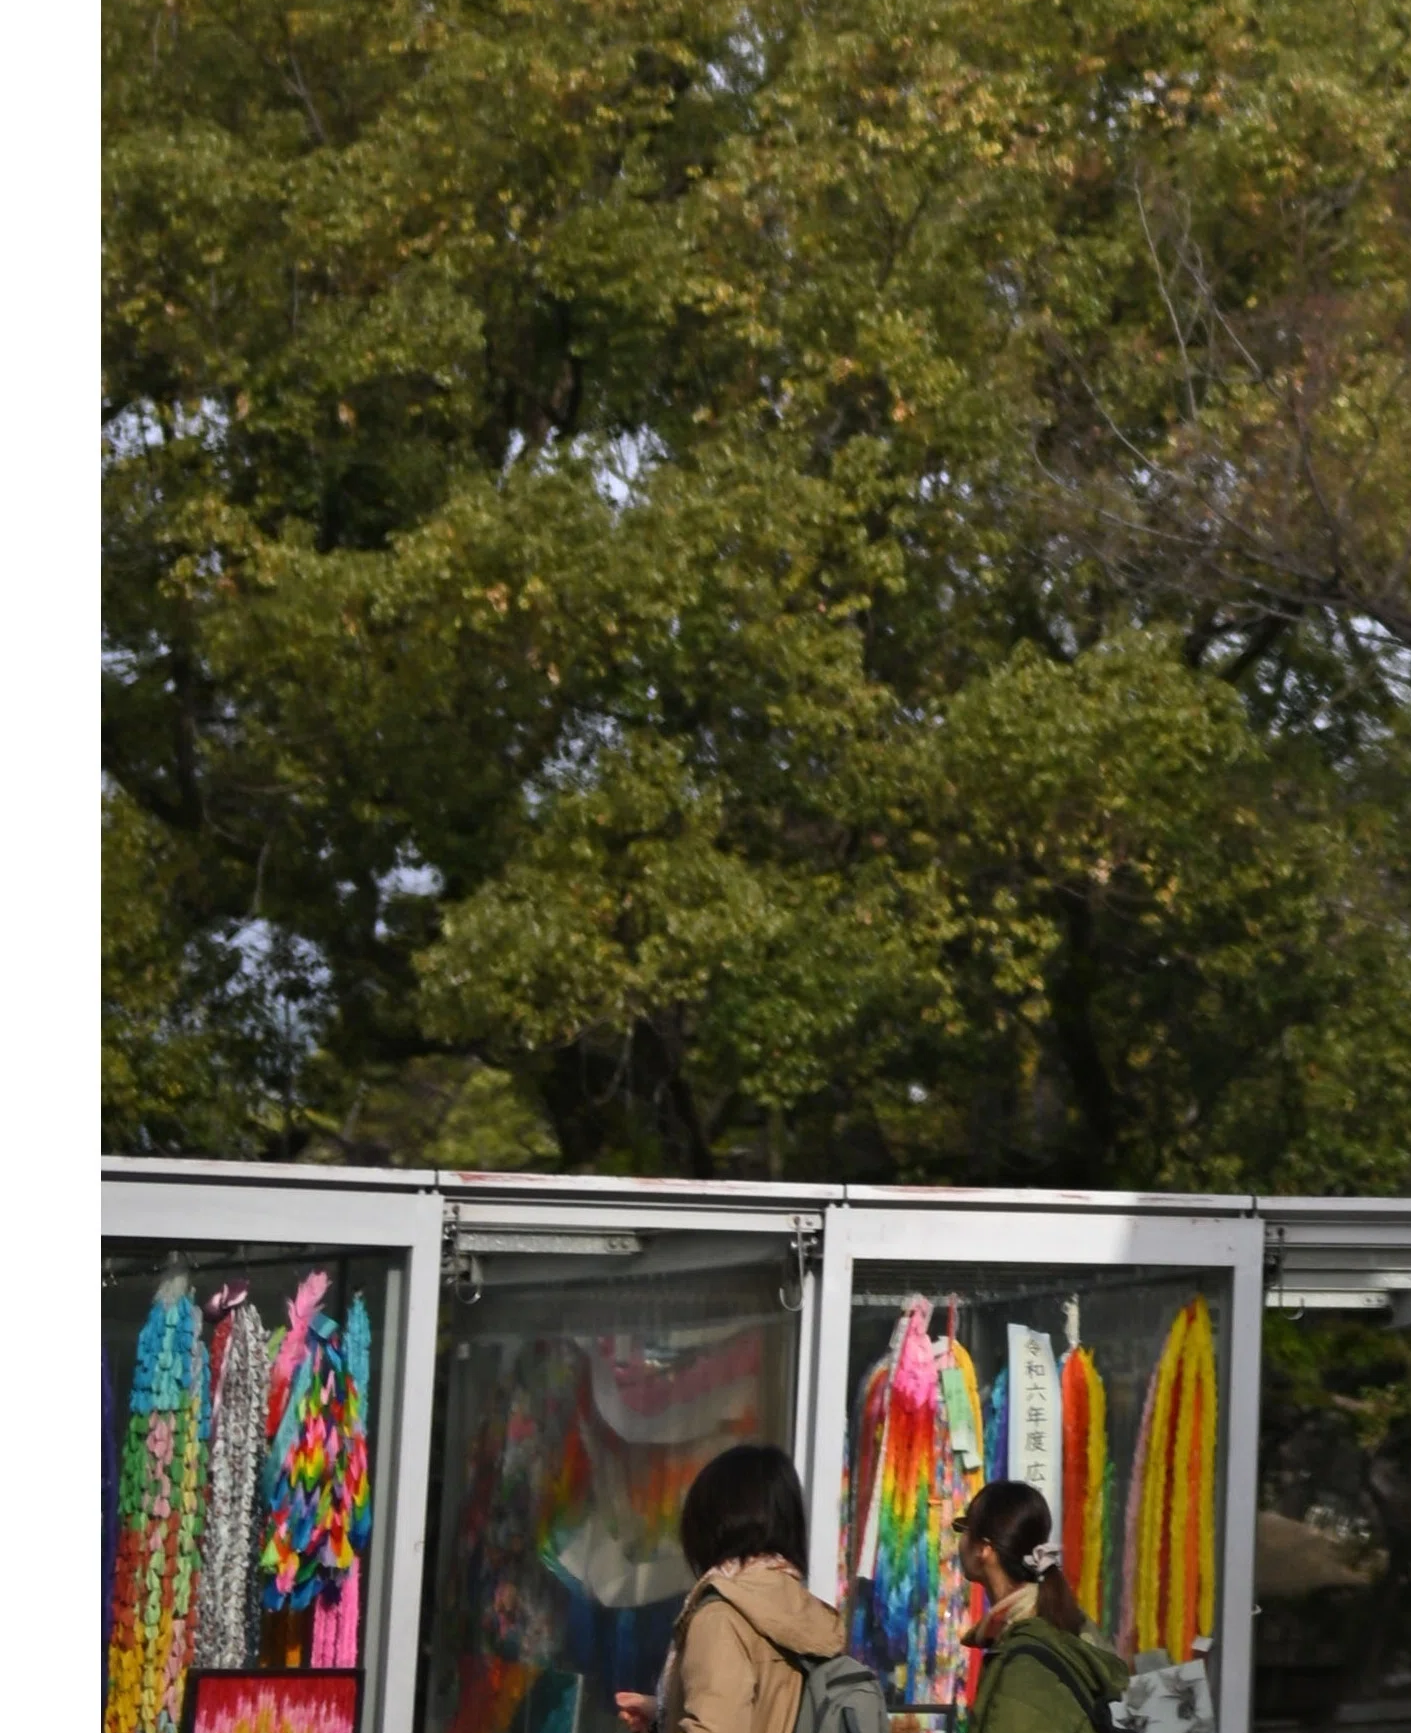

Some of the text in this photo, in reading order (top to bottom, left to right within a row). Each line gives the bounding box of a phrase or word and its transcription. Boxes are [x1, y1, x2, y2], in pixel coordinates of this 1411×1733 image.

[1025, 1337, 1048, 1493] 令和六年度広
